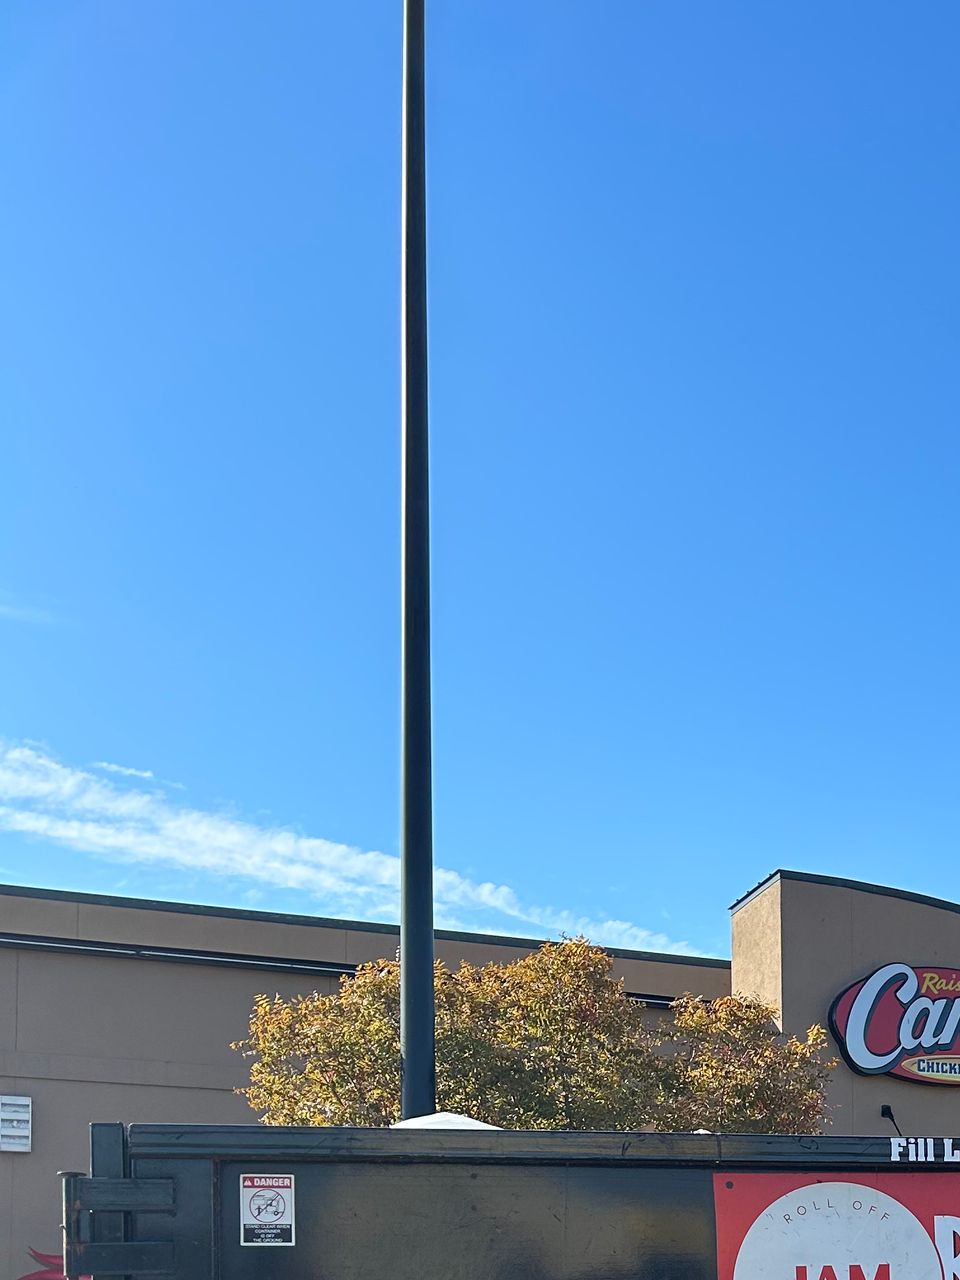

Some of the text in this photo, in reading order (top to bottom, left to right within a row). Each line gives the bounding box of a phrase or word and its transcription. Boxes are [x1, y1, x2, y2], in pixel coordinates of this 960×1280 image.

[890, 1137, 935, 1162] Fill
[253, 1177, 291, 1186] DANGER
[783, 1198, 891, 1224] ROLL OFF
